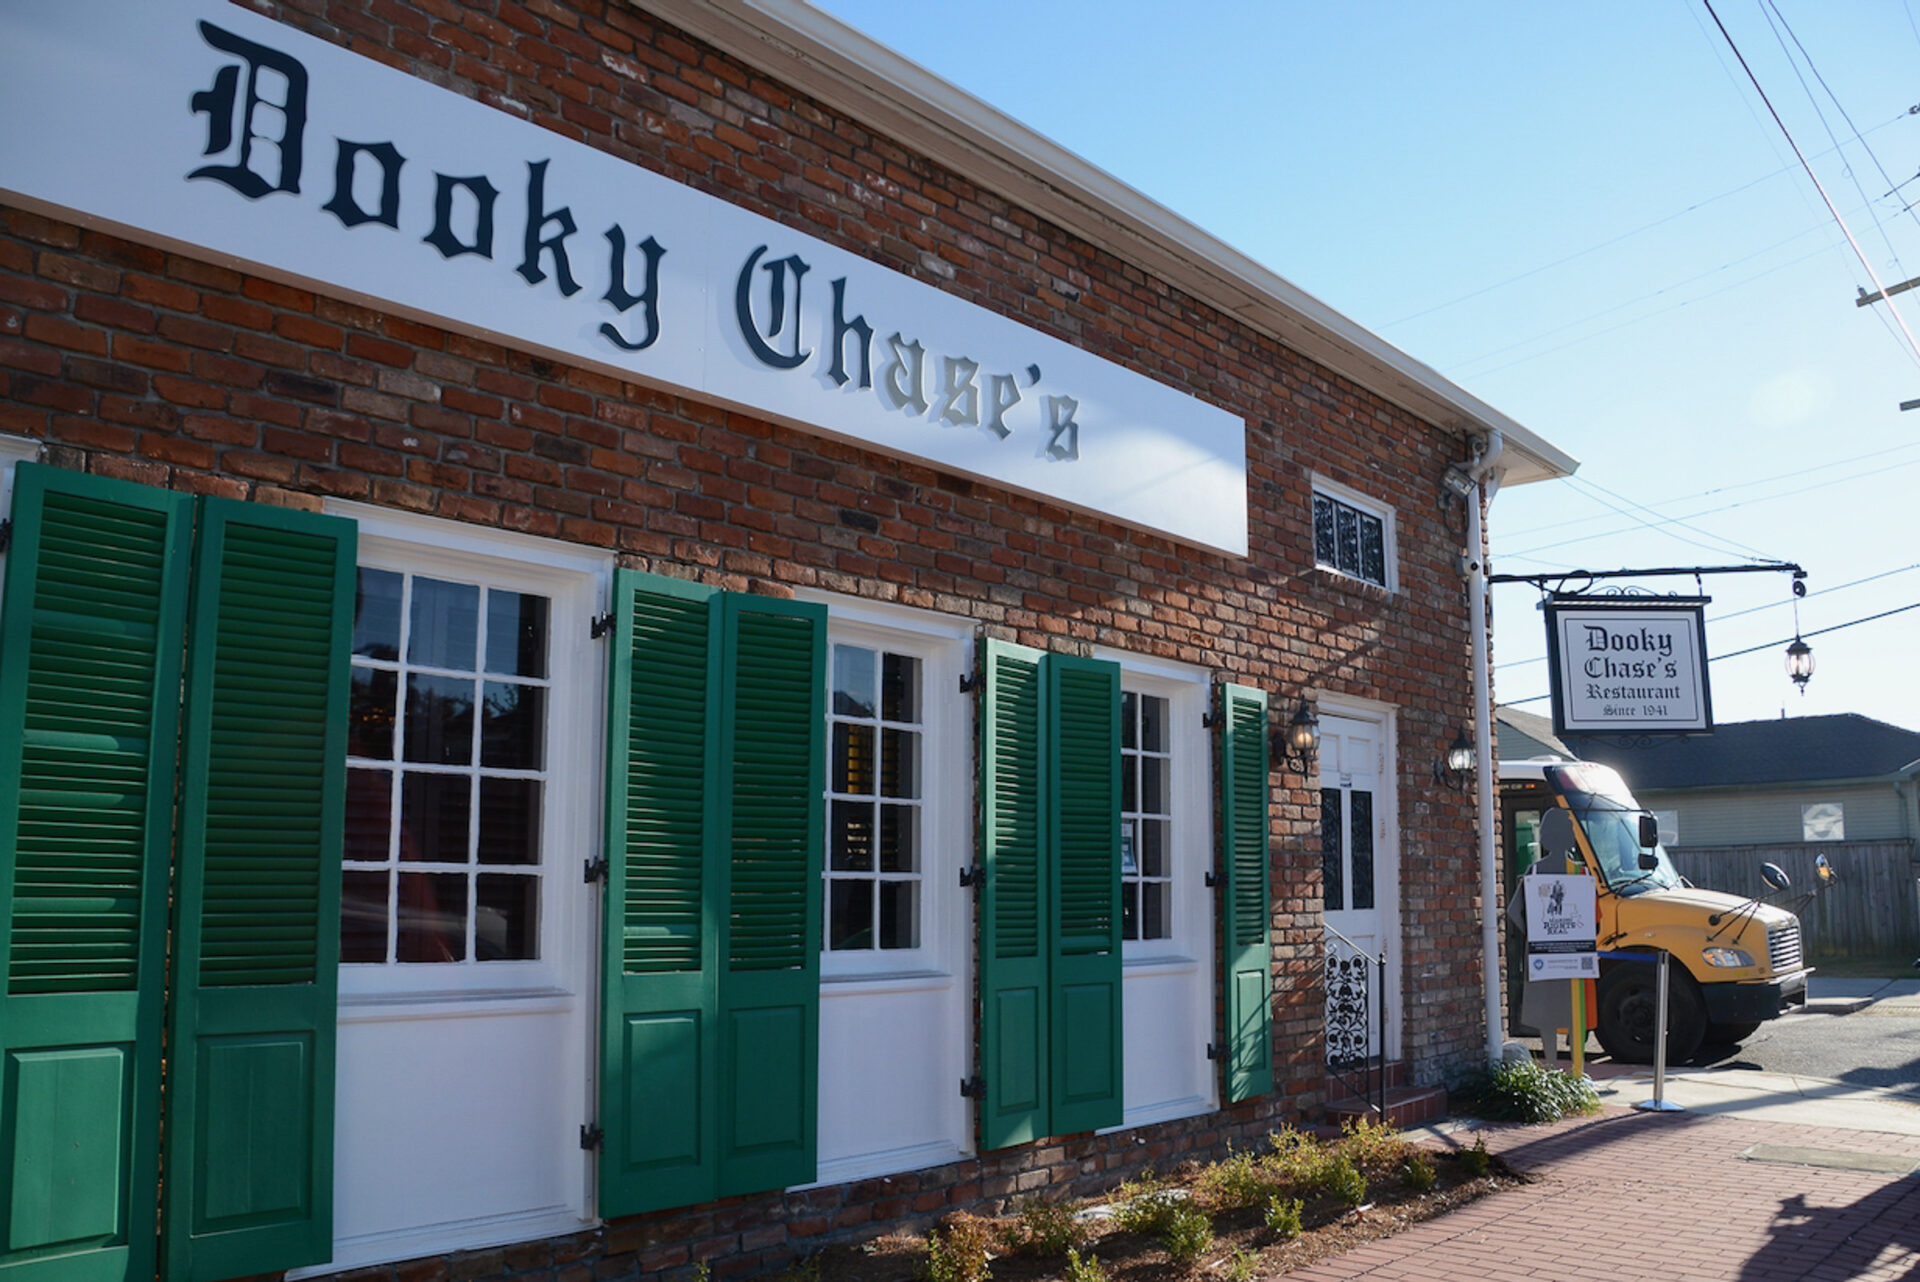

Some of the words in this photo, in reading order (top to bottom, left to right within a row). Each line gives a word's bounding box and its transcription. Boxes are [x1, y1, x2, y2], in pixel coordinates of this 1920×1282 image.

[186, 18, 668, 351] Dooky
[735, 244, 1081, 462] Chase's
[1583, 624, 1672, 656] Dooky
[1584, 657, 1677, 678] Chase's
[1586, 684, 1680, 699] Restaurant
[1603, 704, 1636, 716] Since
[1643, 705, 1668, 716] 1941
